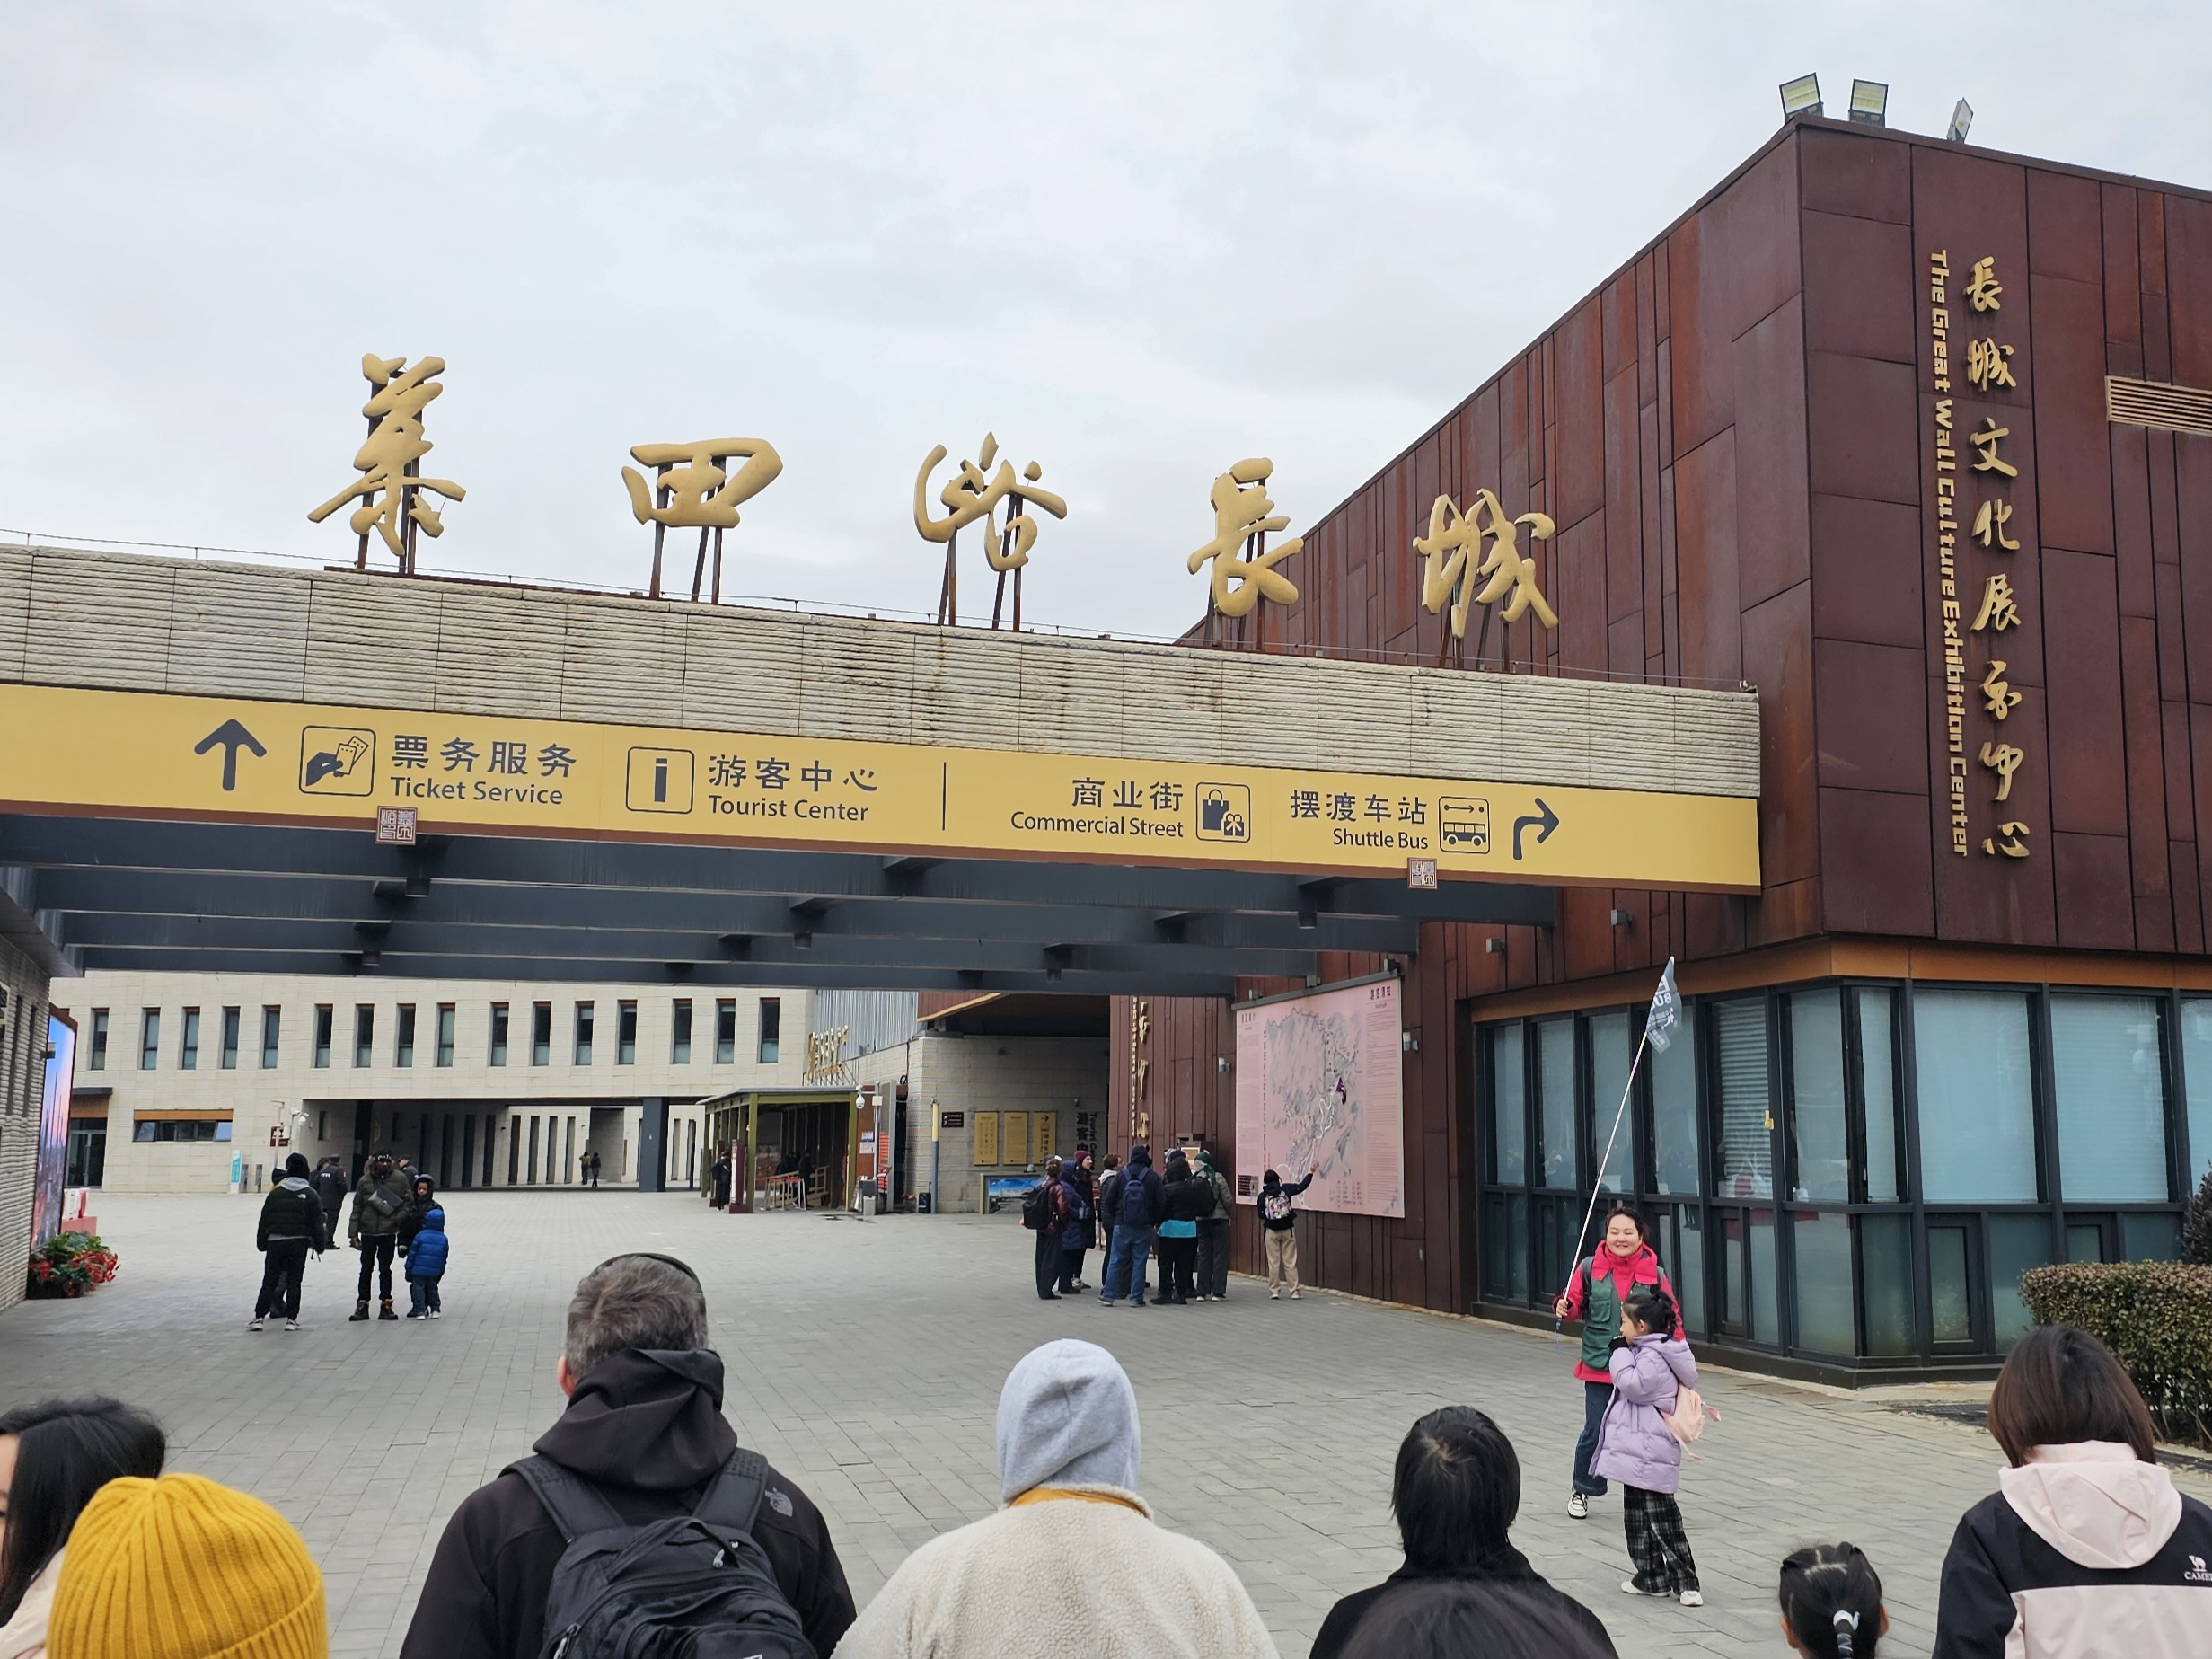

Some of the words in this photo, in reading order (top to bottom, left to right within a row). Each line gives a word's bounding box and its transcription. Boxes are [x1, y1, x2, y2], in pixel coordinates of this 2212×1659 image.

[1929, 250, 1950, 304] The
[1931, 308, 1952, 393] Great
[1934, 399, 1956, 472] Wall
[1937, 478, 1958, 596] Culture
[1942, 599, 1965, 753] Exhibition
[392, 735, 577, 777] 票务服务
[709, 754, 877, 792] 游客中心
[391, 777, 466, 799] Ticket
[473, 781, 563, 805] Service
[709, 795, 787, 817] Tourist
[794, 799, 868, 821] Center
[1072, 777, 1184, 812] 商业街
[1291, 790, 1427, 825] 摆渡车站
[1950, 755, 1969, 857] Center
[1011, 811, 1124, 834] Commercial
[1130, 817, 1184, 837] Street
[1333, 828, 1394, 847] Shuttle
[1398, 832, 1429, 849] Bus
[2184, 1571, 2212, 1582] CAME
